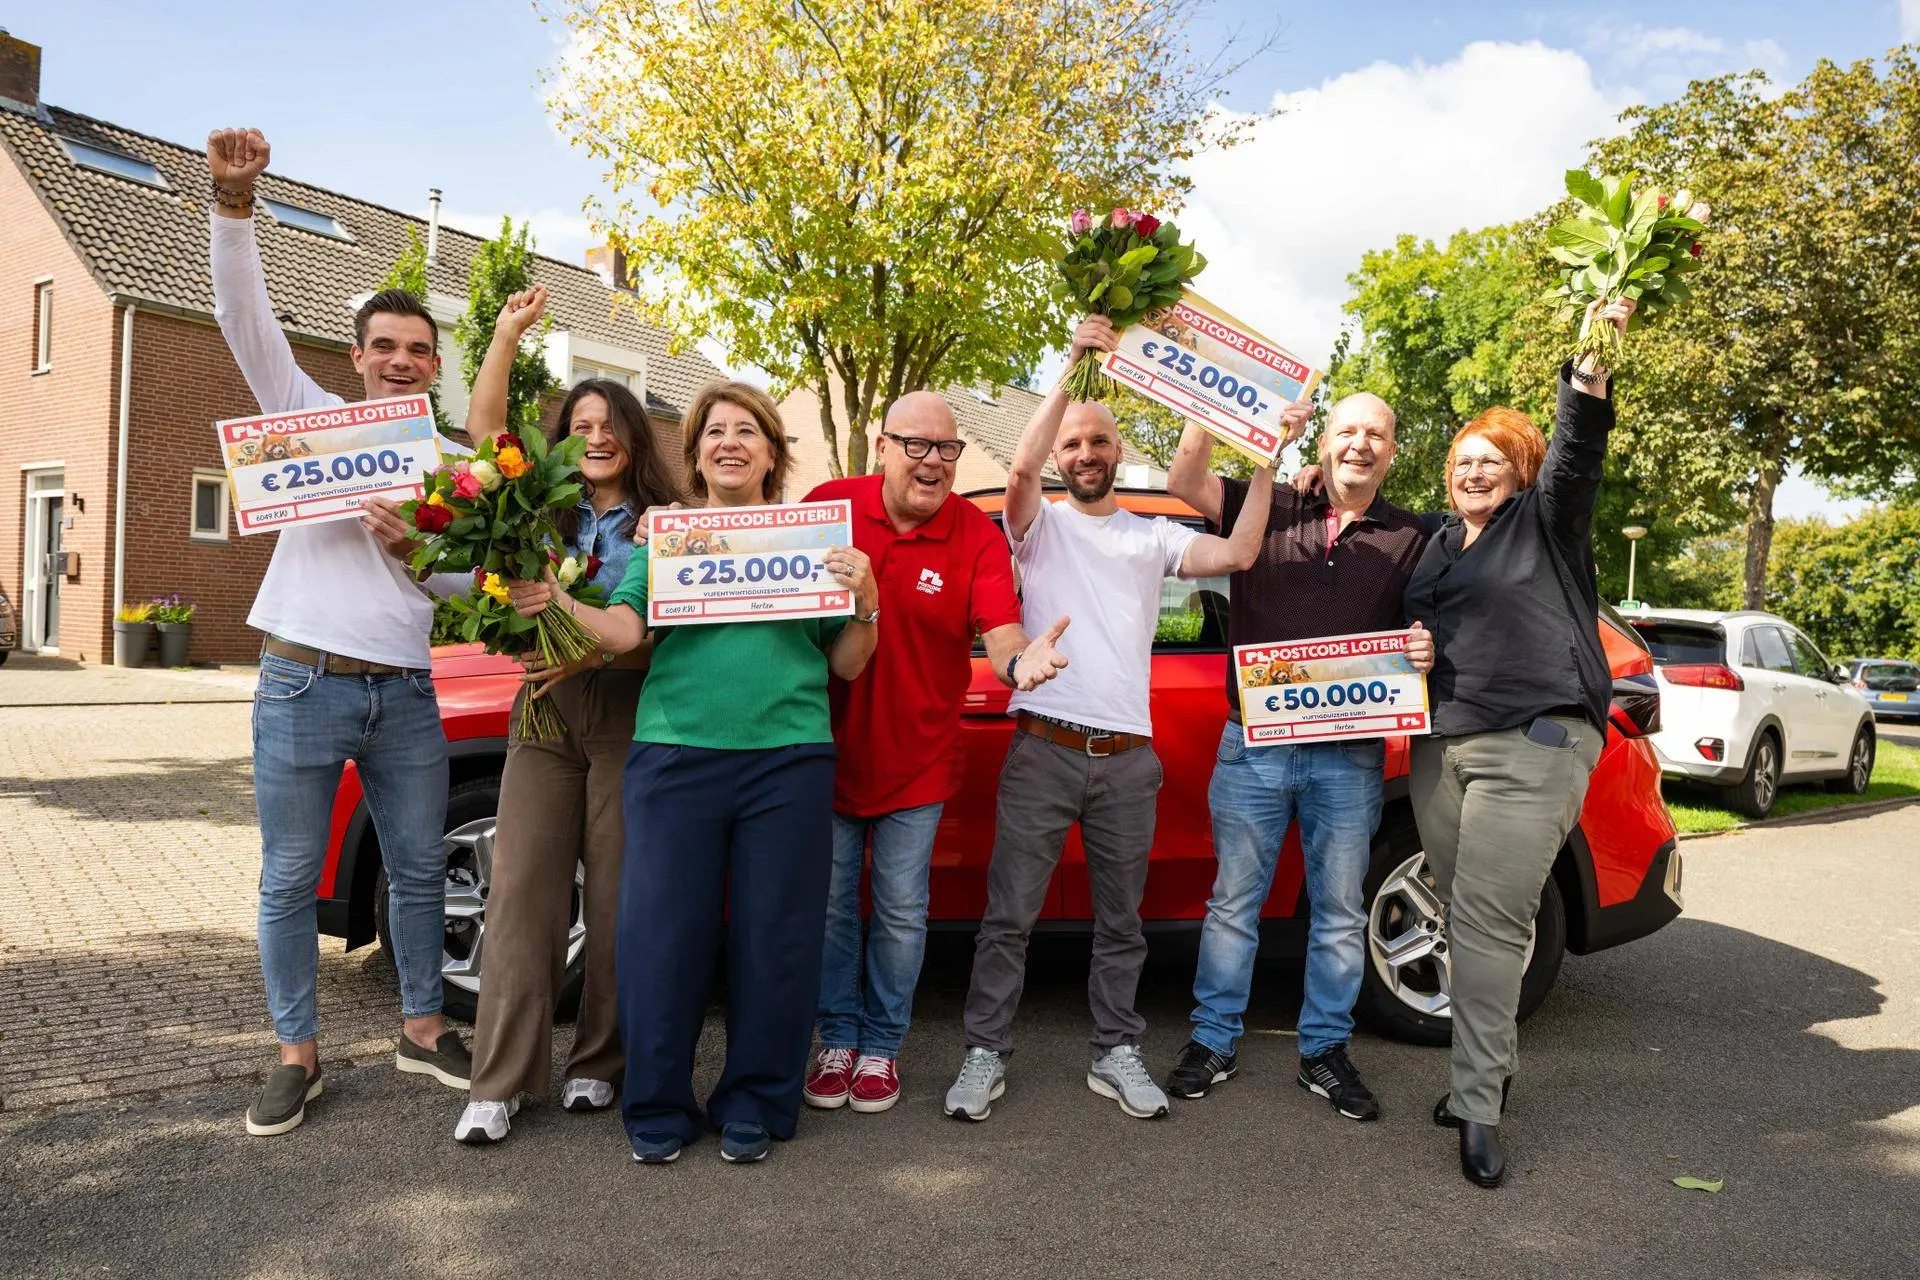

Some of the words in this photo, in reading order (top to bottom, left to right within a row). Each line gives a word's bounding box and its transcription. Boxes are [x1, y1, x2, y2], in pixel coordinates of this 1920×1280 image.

[1173, 305, 1246, 350] POSTCODE
[1247, 341, 1303, 378] LOTERIJ
[1156, 370, 1223, 409] VIJFENTWINTIGDUIZEND
[1221, 403, 1239, 416] EURO
[260, 411, 353, 435] POSTCODE
[354, 401, 420, 424] LOTERIJ
[1190, 401, 1210, 416] Herten
[292, 483, 374, 501] VIJFENTWINTIGDUIZEND
[374, 481, 393, 490] EURO
[688, 511, 774, 531] POSTCODE
[776, 507, 840, 524] LOTERIJ
[703, 588, 781, 598] VIJFENTWINTIGDUIZEND
[782, 586, 800, 595] EURO
[750, 601, 775, 611] Herten
[1270, 643, 1350, 662] POSTCODE
[1350, 638, 1404, 655] LOTERI
[1301, 712, 1349, 720] VIJFTIGDUIZEND
[1334, 723, 1355, 732] Herten
